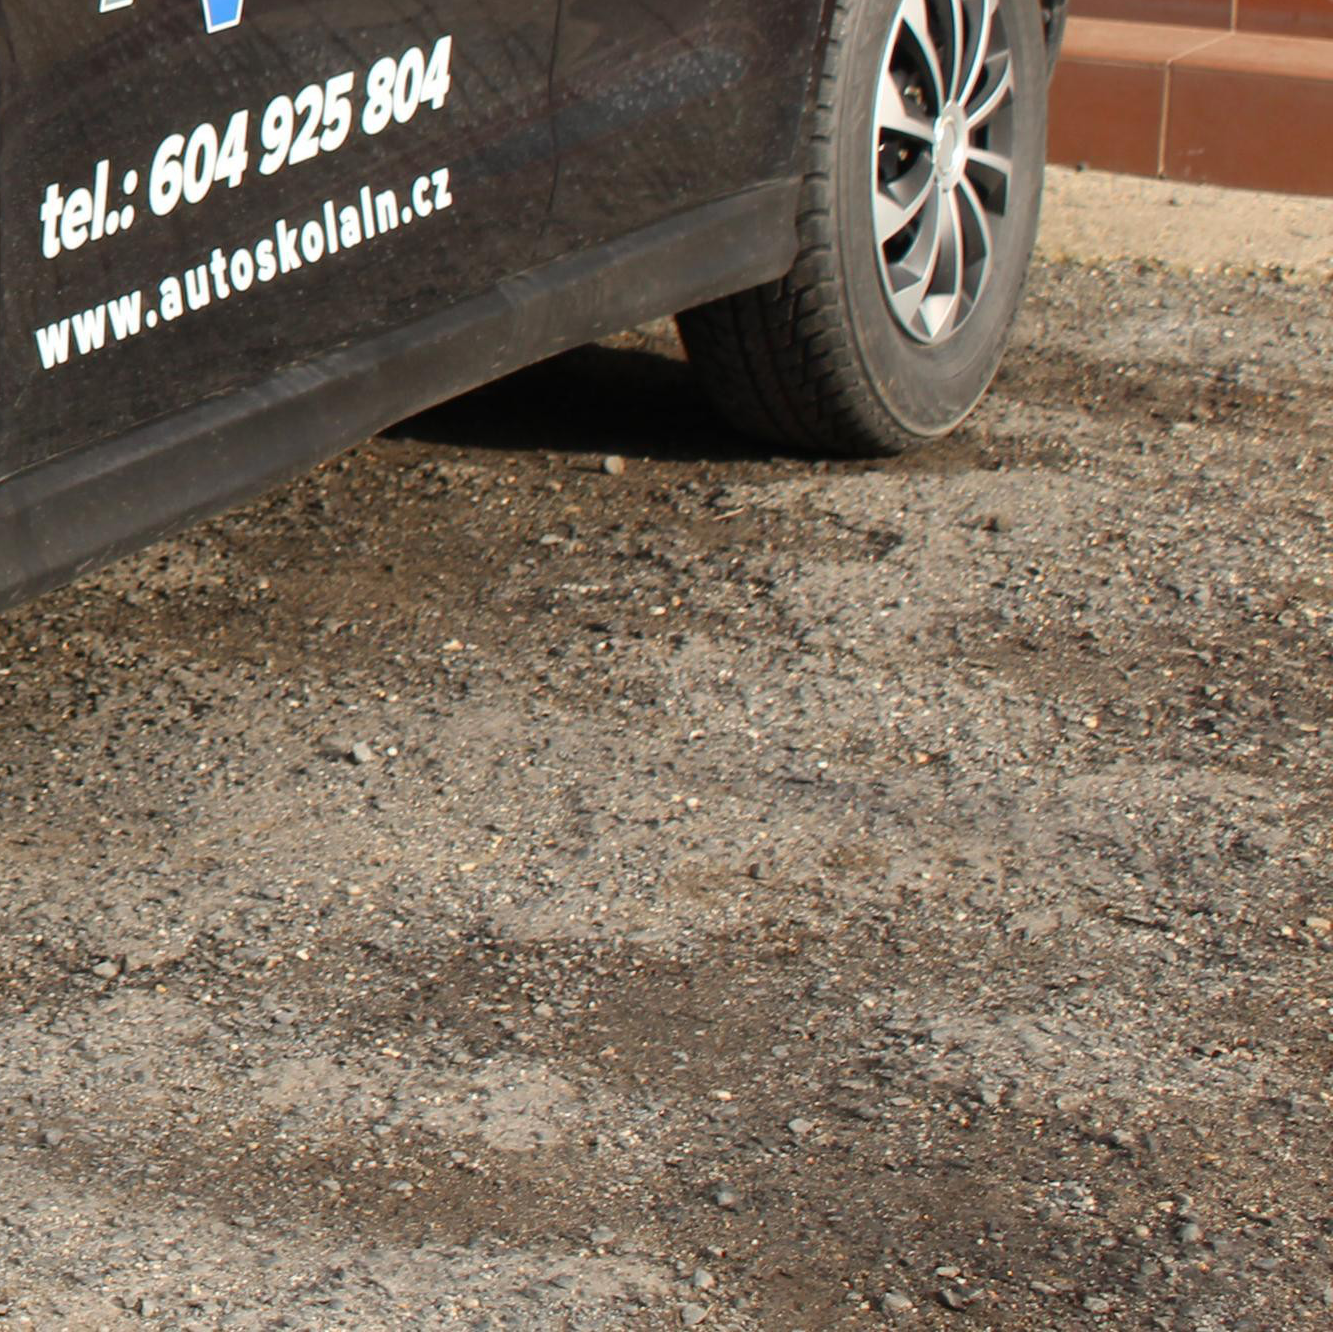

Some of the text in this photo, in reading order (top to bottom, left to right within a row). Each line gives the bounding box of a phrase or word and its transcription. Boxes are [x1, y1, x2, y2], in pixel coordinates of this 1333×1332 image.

[39, 35, 452, 259] tel.: 604 925 804
[35, 168, 453, 370] www.autoskolaln.cz
